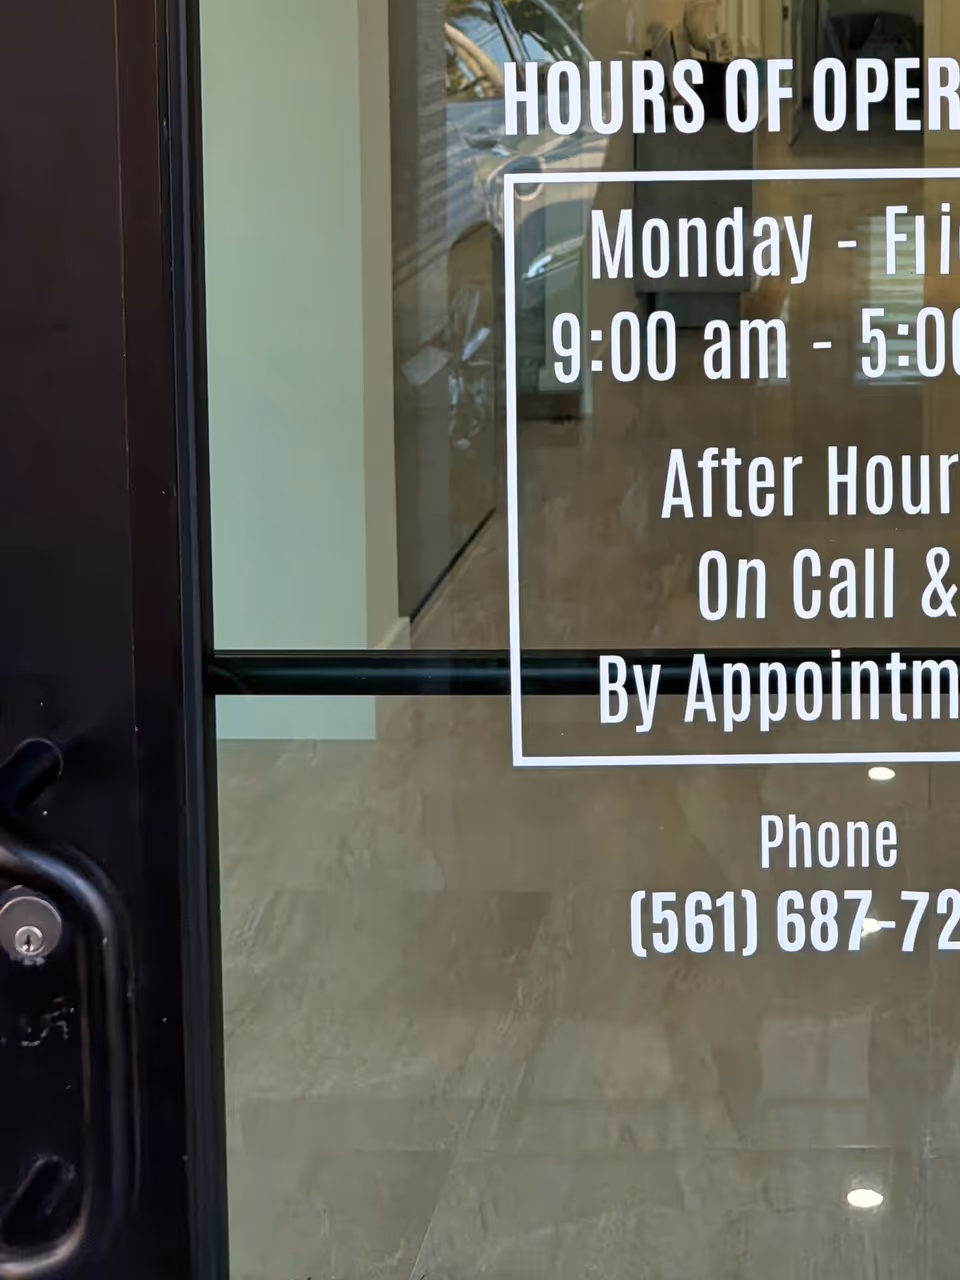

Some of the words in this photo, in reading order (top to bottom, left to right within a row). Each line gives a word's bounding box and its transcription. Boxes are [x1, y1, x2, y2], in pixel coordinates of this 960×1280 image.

[503, 59, 705, 136] HOURS
[725, 57, 794, 134] OF
[590, 206, 814, 285] Monday
[837, 238, 858, 249] -
[552, 311, 677, 384] 9:00
[703, 317, 788, 381] am
[812, 339, 833, 349] -
[661, 447, 803, 519] After
[699, 549, 767, 621] On
[792, 547, 895, 619] Call
[921, 546, 957, 618] &
[599, 654, 660, 733] By
[760, 814, 898, 868] Phone
[630, 889, 758, 957] (561)
